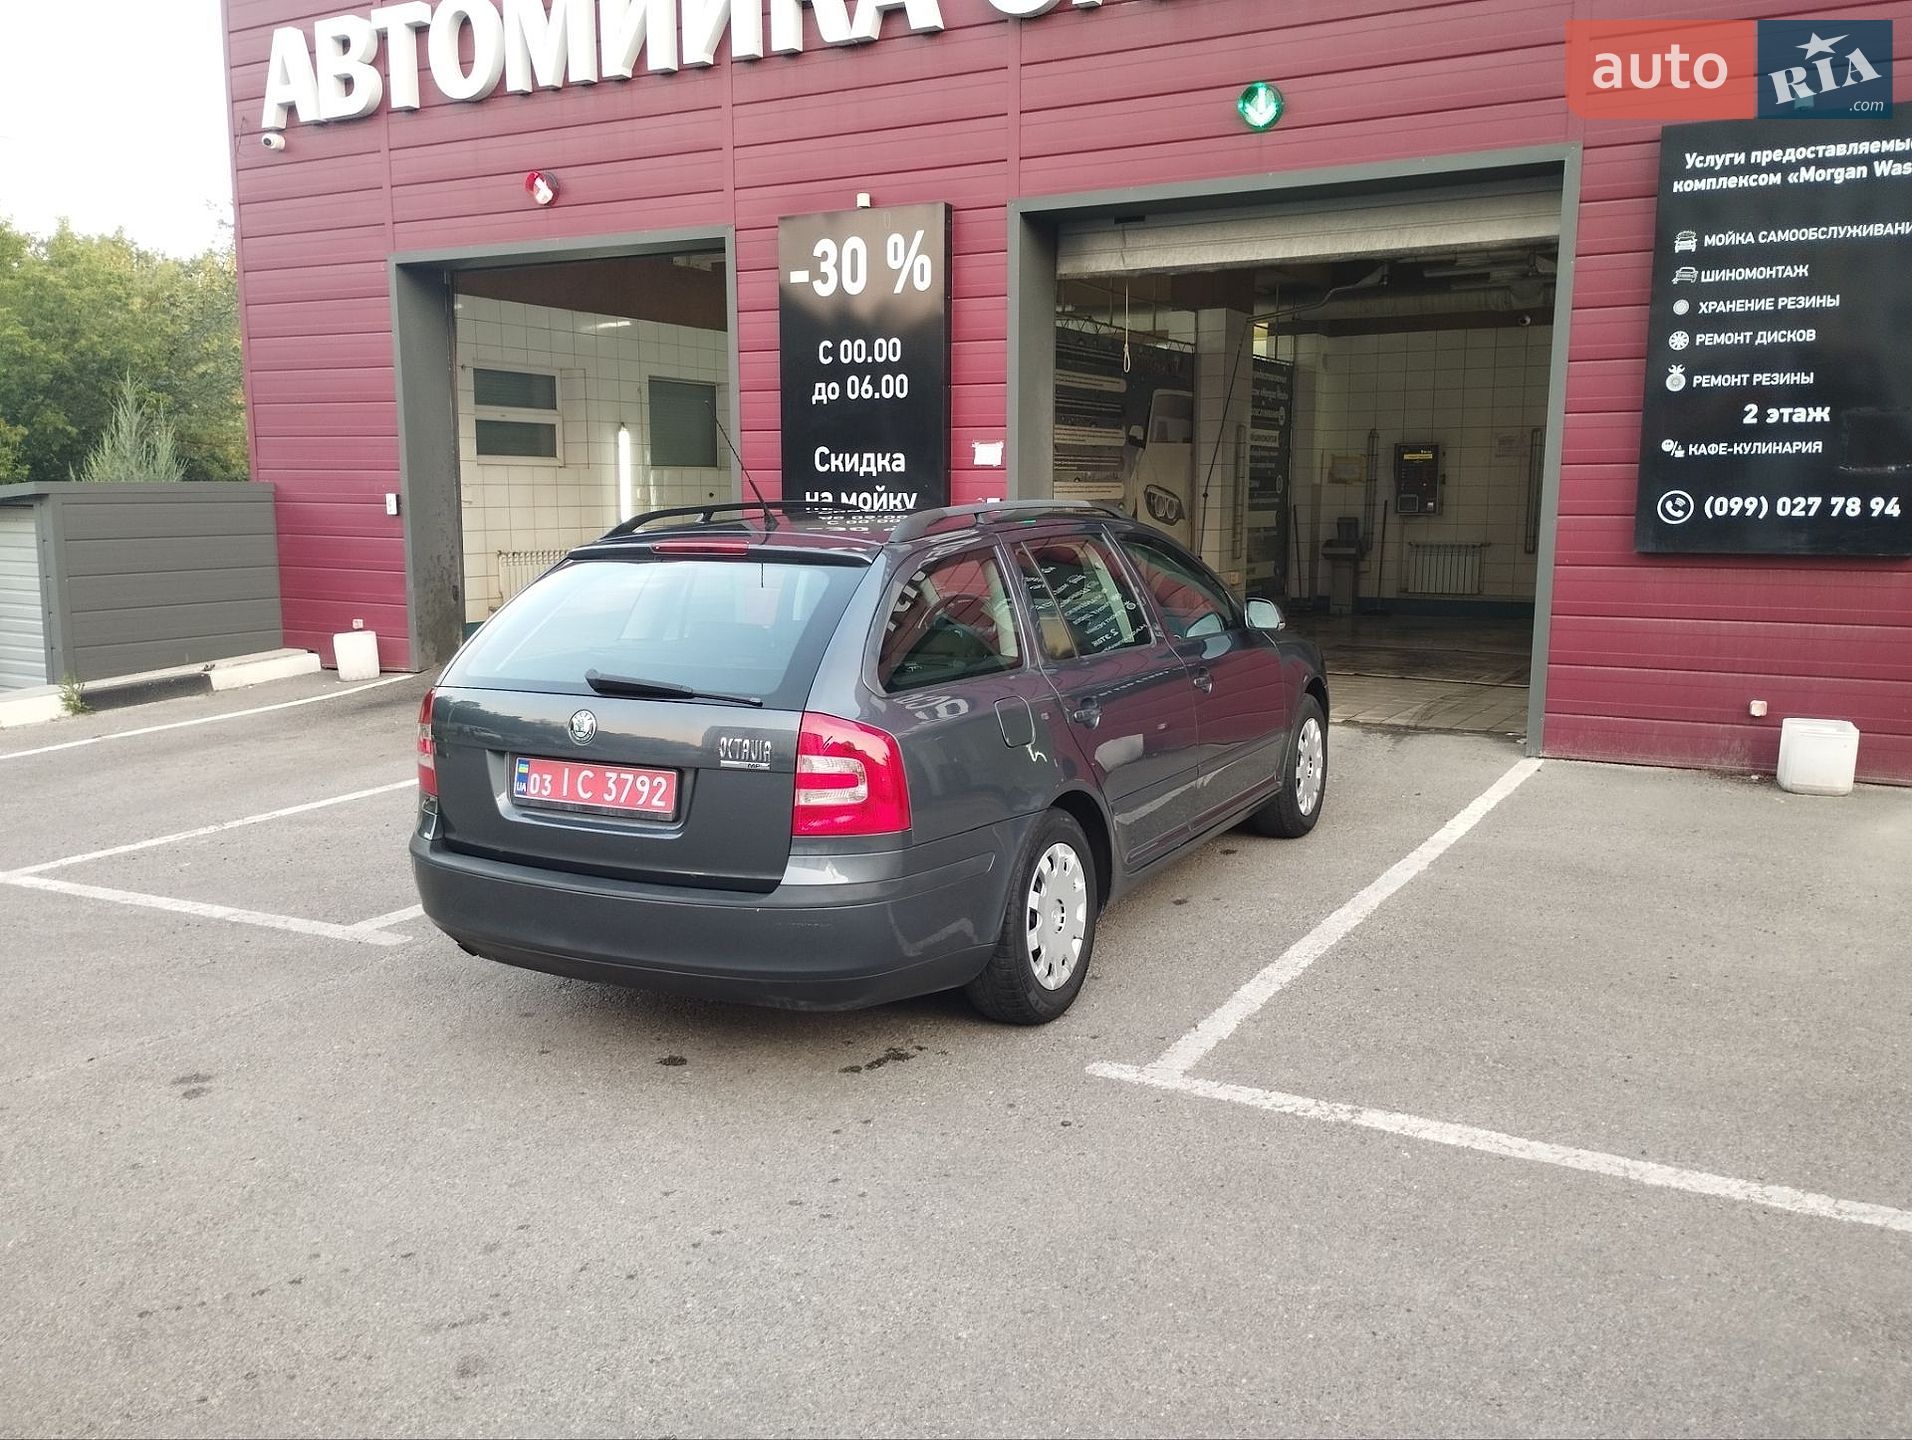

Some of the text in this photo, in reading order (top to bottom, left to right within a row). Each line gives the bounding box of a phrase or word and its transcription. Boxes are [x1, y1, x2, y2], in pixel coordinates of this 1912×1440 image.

[1685, 137, 1912, 170] Услуги предоставляемы
[1673, 172, 1782, 192] комплексом
[1787, 166, 1868, 184] «Morgan
[1704, 230, 1755, 247] МОЙКА
[789, 229, 932, 298] -30 %
[1701, 264, 1809, 282] ШИНОМОНТАЖ
[1698, 294, 1841, 314] ХРАНЕНИЕ РЕЗИНЫ
[1695, 329, 1817, 346] РЕМОНТ ДИСКОВ
[839, 337, 902, 364] 00.00
[811, 373, 909, 405] до 06.00
[1692, 371, 1815, 388] РЕМОНТ РЕЗИНЫ
[1742, 403, 1831, 424] 2 этаж
[1688, 440, 1823, 456] КАФЕ-КУЛИНАРИЯ
[814, 445, 906, 477] Скидка
[840, 485, 918, 513] мойку
[1704, 495, 1902, 519] (099) 027 78 94
[719, 737, 772, 762] OCTAVIA
[529, 773, 552, 796] 03
[602, 771, 668, 807] 3792
